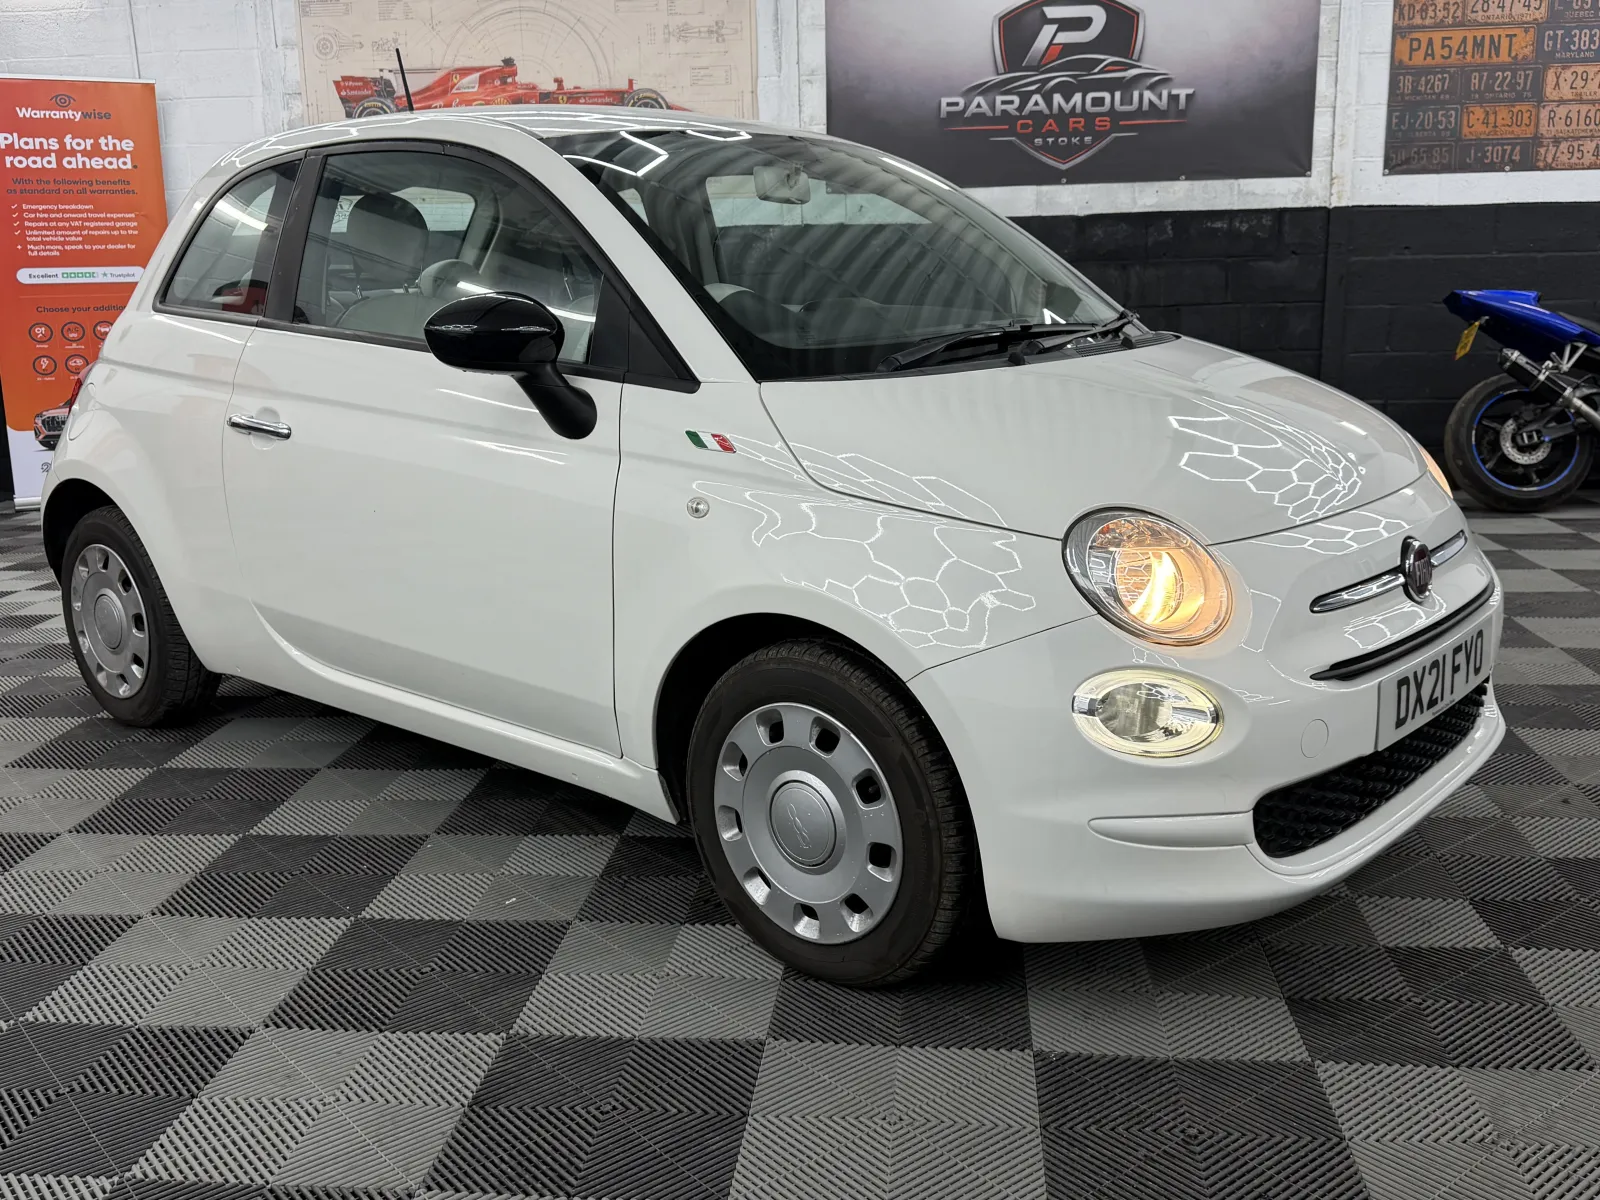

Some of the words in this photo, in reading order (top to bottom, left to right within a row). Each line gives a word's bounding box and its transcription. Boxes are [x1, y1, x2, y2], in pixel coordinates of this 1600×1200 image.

[1408, 33, 1518, 61] PA54MNT
[1555, 51, 1595, 59] MARYLAND
[586, 95, 613, 103] Santander
[940, 88, 1195, 118] PARAMOUNT
[16, 107, 111, 121] Warrantywise
[1017, 117, 1111, 133] CARS
[0, 132, 59, 149] Plans
[64, 134, 94, 151] for
[99, 135, 135, 151] the
[1034, 136, 1092, 146] STOKE
[5, 153, 57, 168] road
[62, 153, 138, 170] ahead.
[53, 178, 93, 187] following
[72, 305, 90, 313] your
